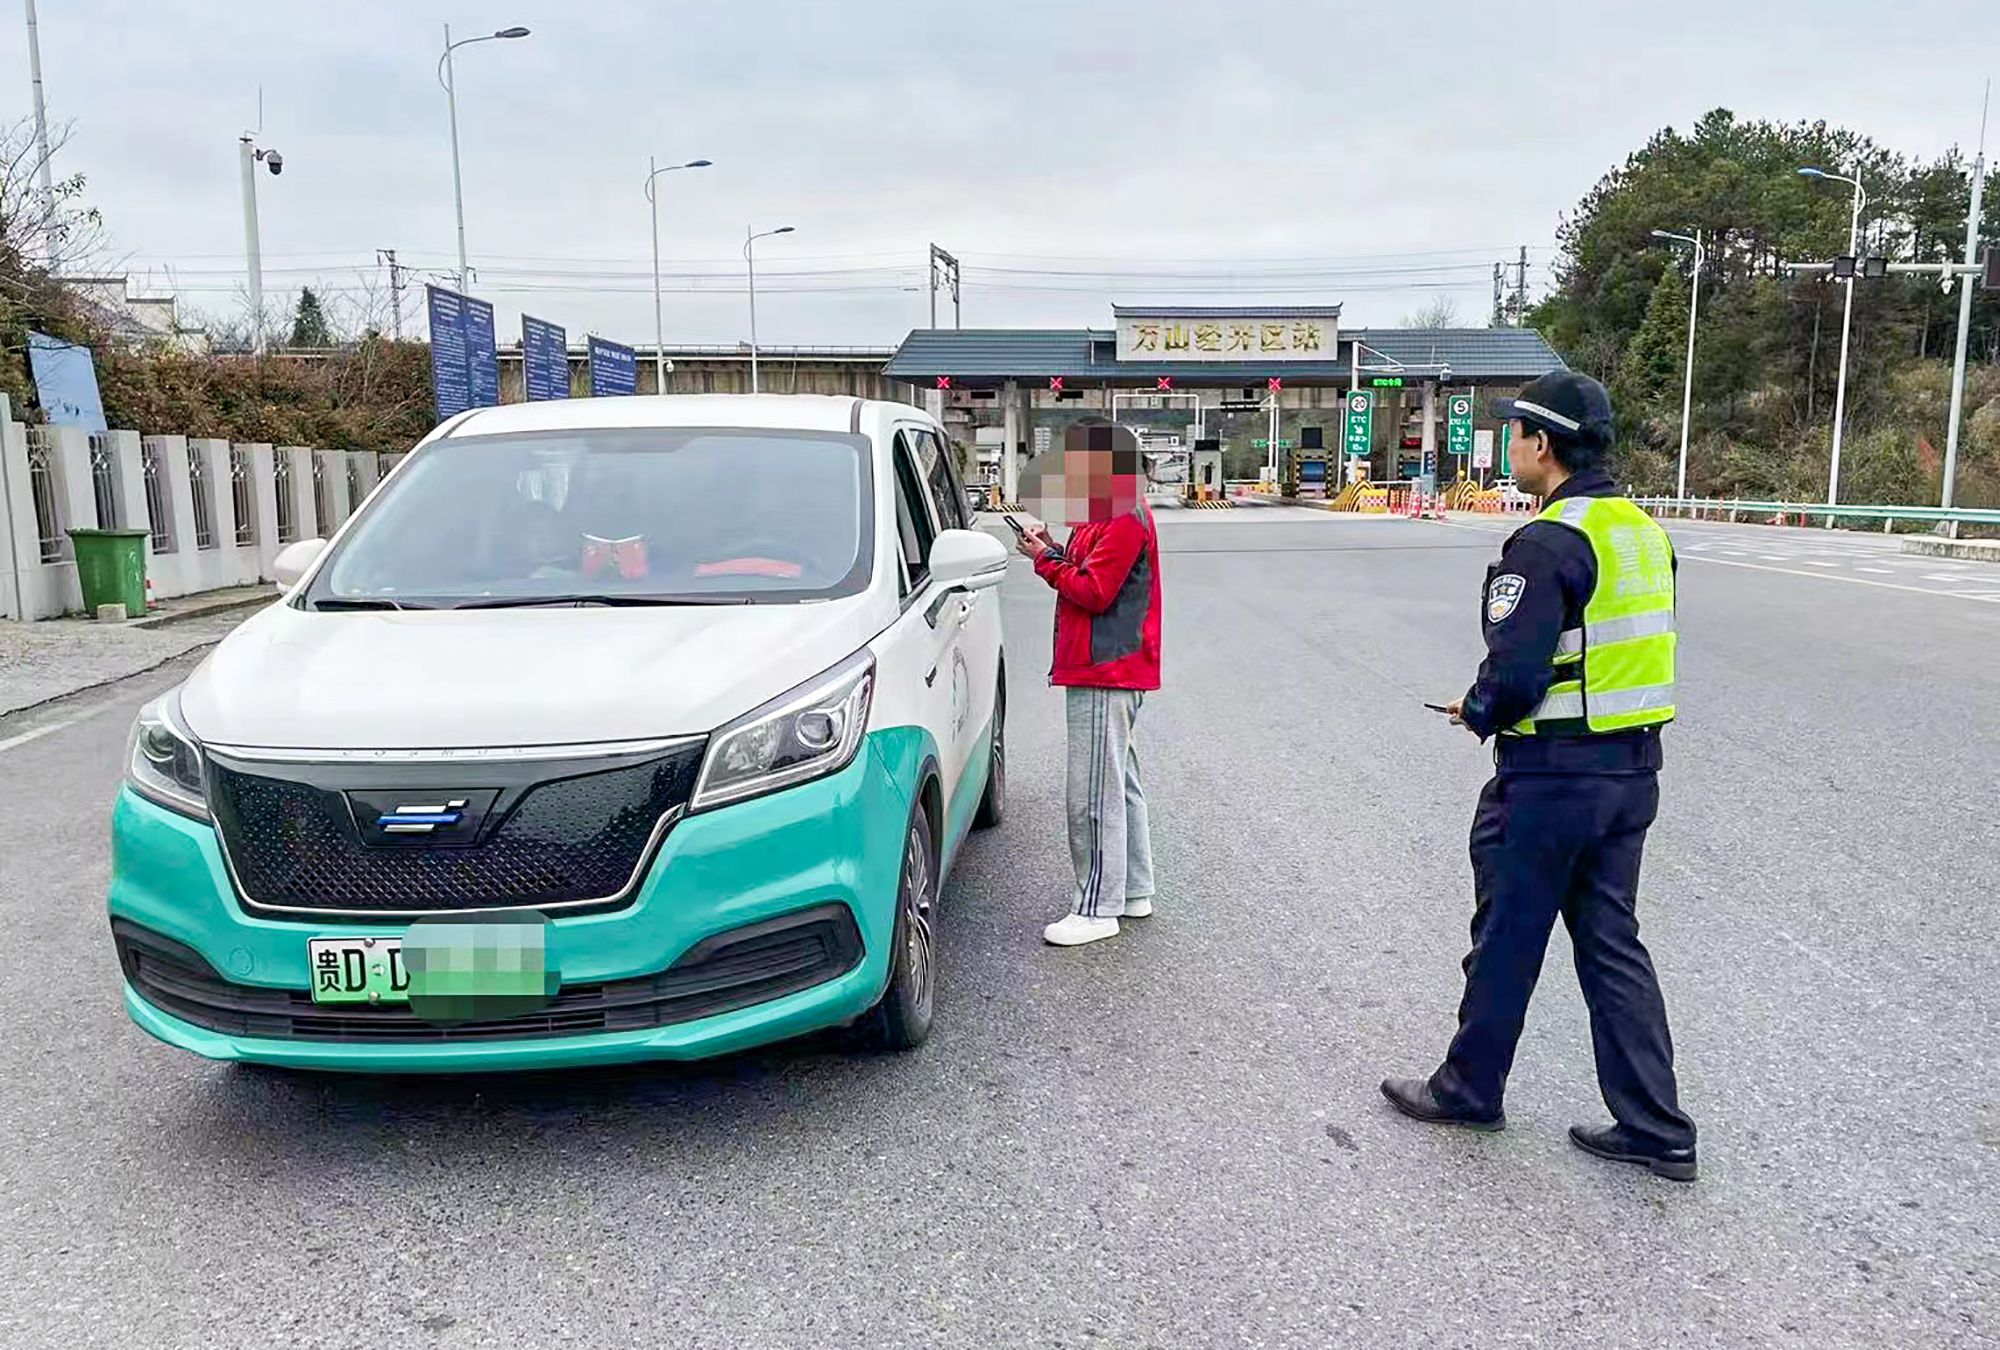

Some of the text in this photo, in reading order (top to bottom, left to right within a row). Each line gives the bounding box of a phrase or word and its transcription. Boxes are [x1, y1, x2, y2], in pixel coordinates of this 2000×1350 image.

[1131, 321, 1320, 352] 万山经开区站
[1353, 398, 1366, 409] 20
